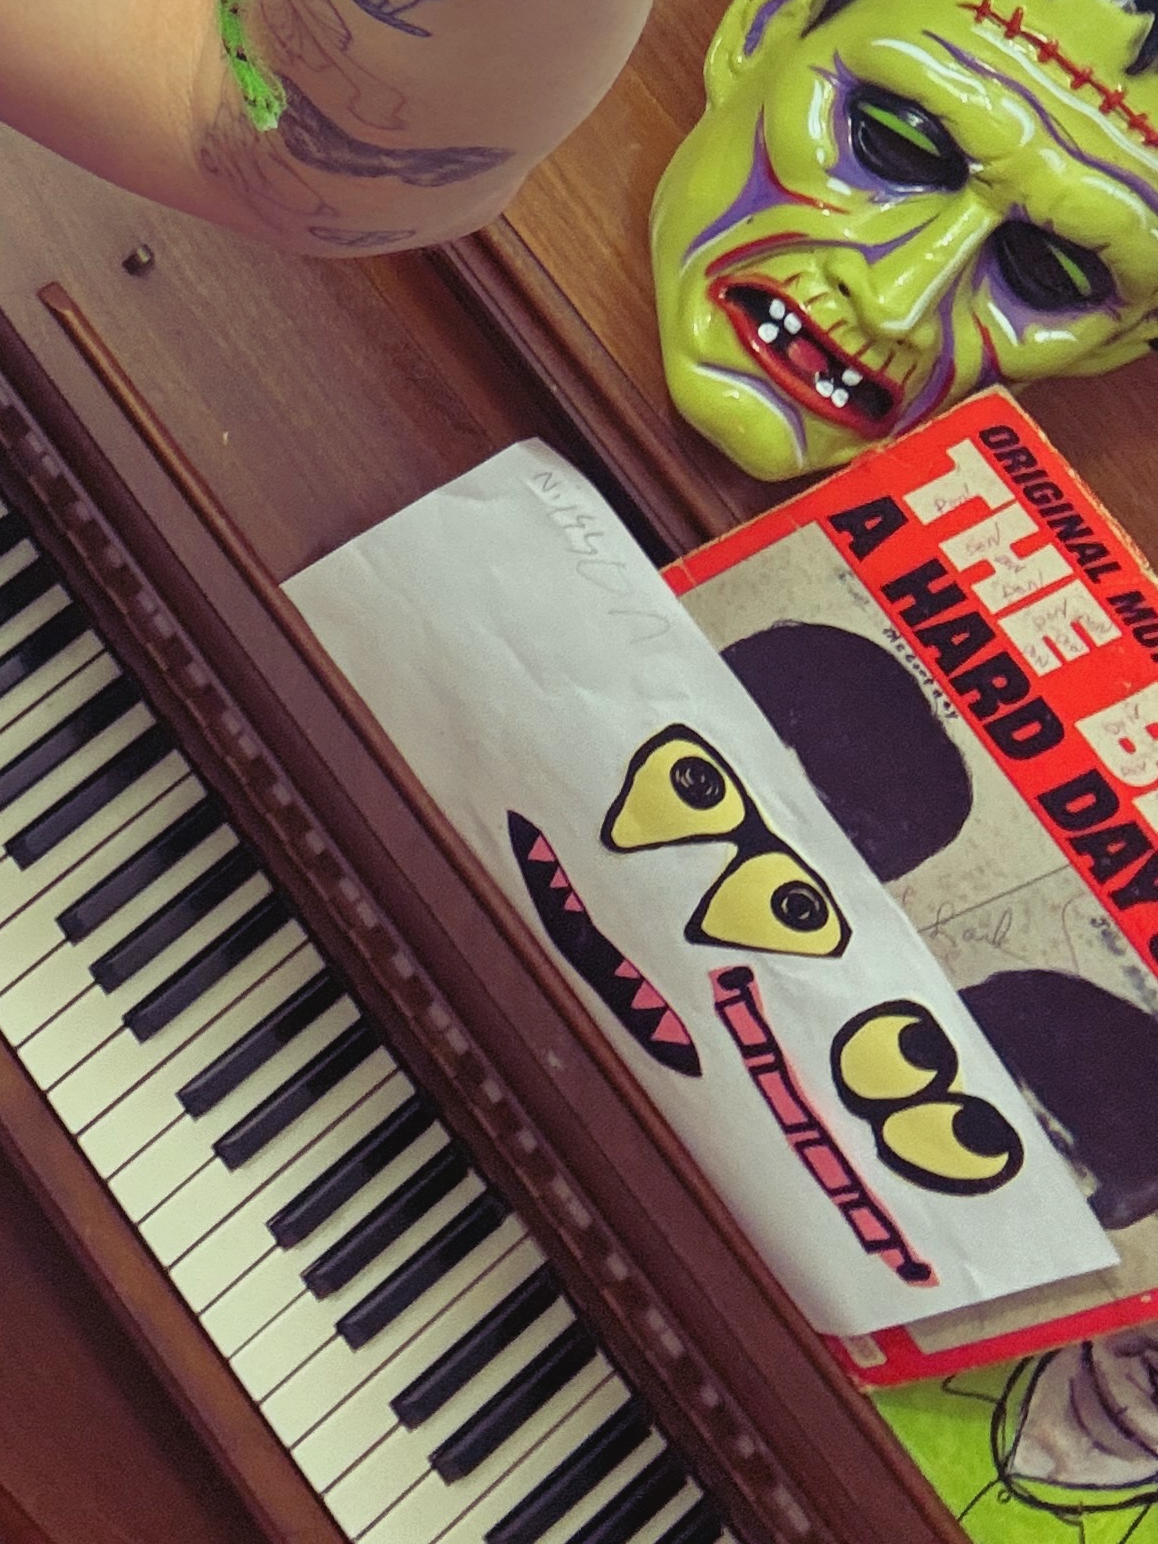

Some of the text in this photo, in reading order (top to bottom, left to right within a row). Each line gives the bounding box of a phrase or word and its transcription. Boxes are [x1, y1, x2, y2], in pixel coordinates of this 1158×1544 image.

[902, 438, 1123, 678] THE
[978, 424, 1122, 585] ORIGINAL
[1106, 589, 1158, 664] MO
[827, 494, 910, 563] A
[879, 556, 1067, 763] HARD
[1036, 767, 1158, 964] DAY
